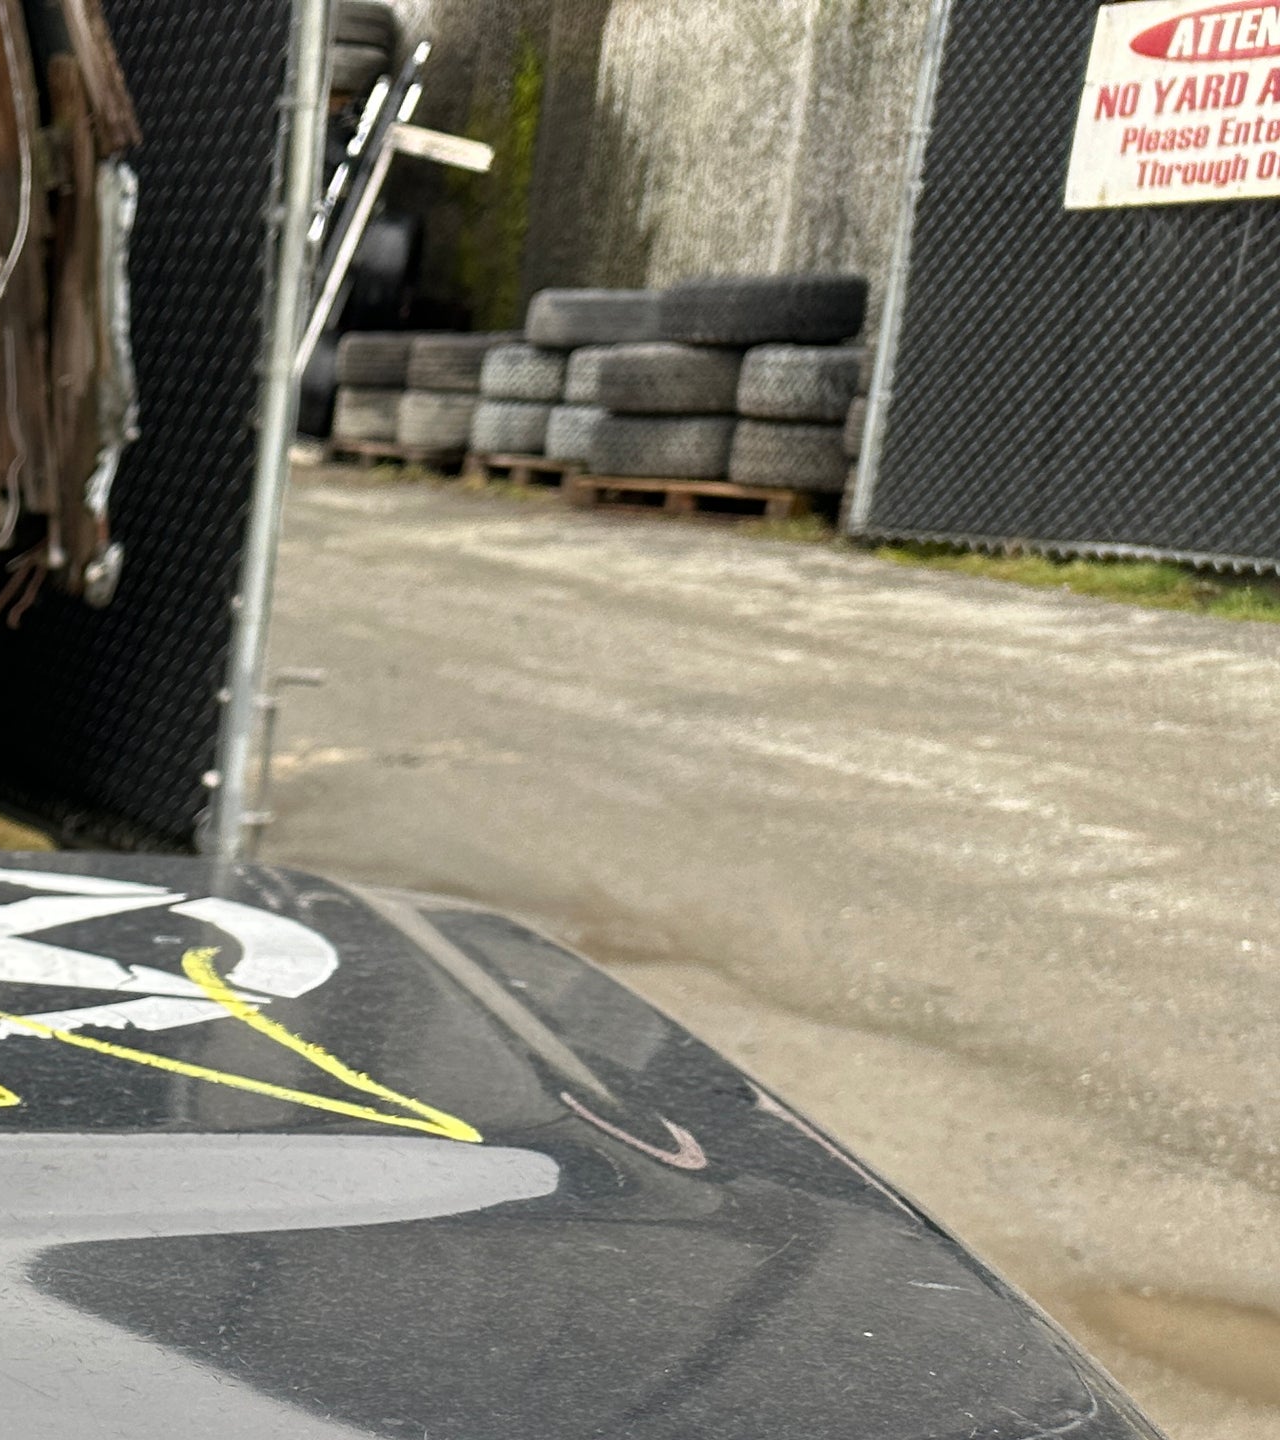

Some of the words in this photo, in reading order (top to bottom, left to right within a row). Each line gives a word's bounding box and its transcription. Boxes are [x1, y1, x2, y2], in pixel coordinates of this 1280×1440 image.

[1094, 82, 1142, 121] NO
[1154, 71, 1250, 117] YARD
[1120, 124, 1211, 154] Please
[1136, 153, 1250, 189] Through
[1256, 151, 1280, 180] O
